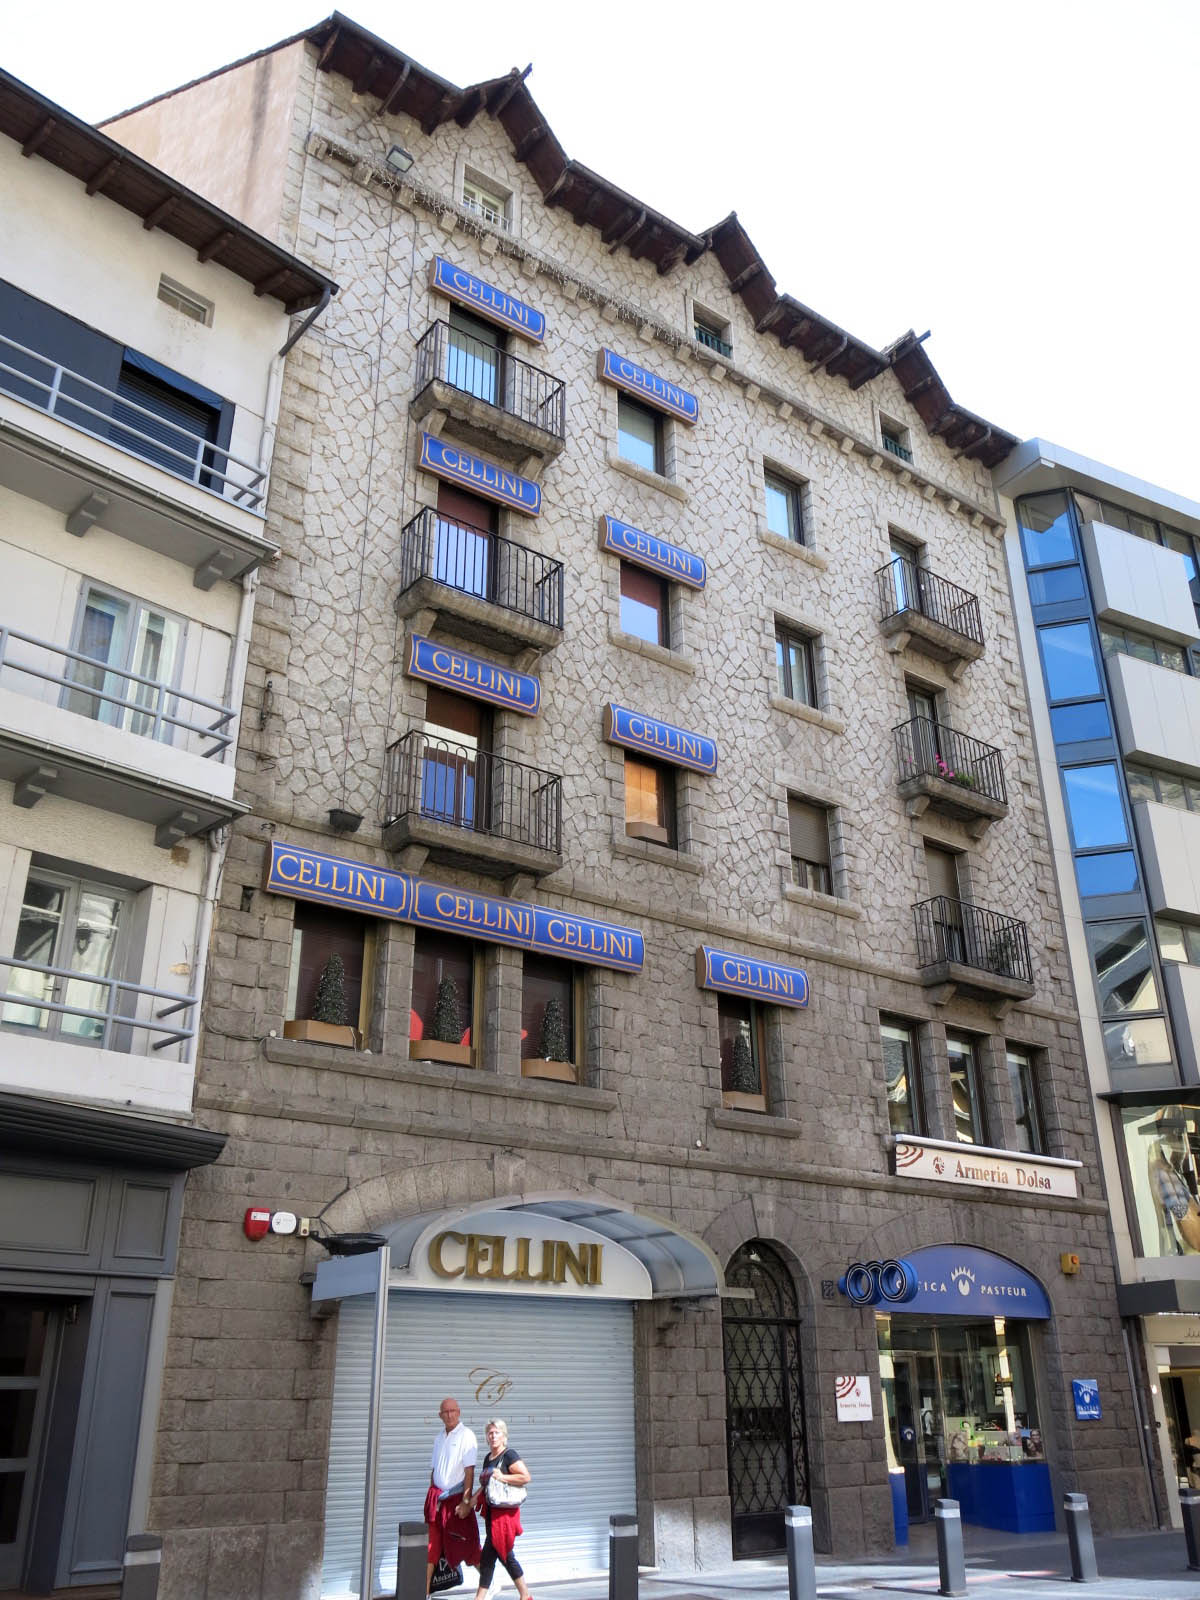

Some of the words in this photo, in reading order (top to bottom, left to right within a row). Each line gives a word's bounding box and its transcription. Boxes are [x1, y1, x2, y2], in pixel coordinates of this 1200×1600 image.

[454, 272, 529, 325] CELLINI
[620, 363, 685, 408] CELLINI
[441, 447, 523, 498] CELLINI
[622, 530, 692, 574] CELLINI
[433, 650, 521, 699] CELLINI
[629, 717, 702, 760] CELLINI
[276, 856, 386, 903] CELLINI
[436, 892, 531, 938] CELLINI
[548, 919, 633, 960] CELLINI
[722, 960, 795, 995] CELLINI
[955, 1159, 1009, 1184] Armeria
[1016, 1168, 1051, 1189] Dolsa
[428, 1230, 604, 1286] CELLINI
[980, 1285, 1027, 1297] PASTEUR
